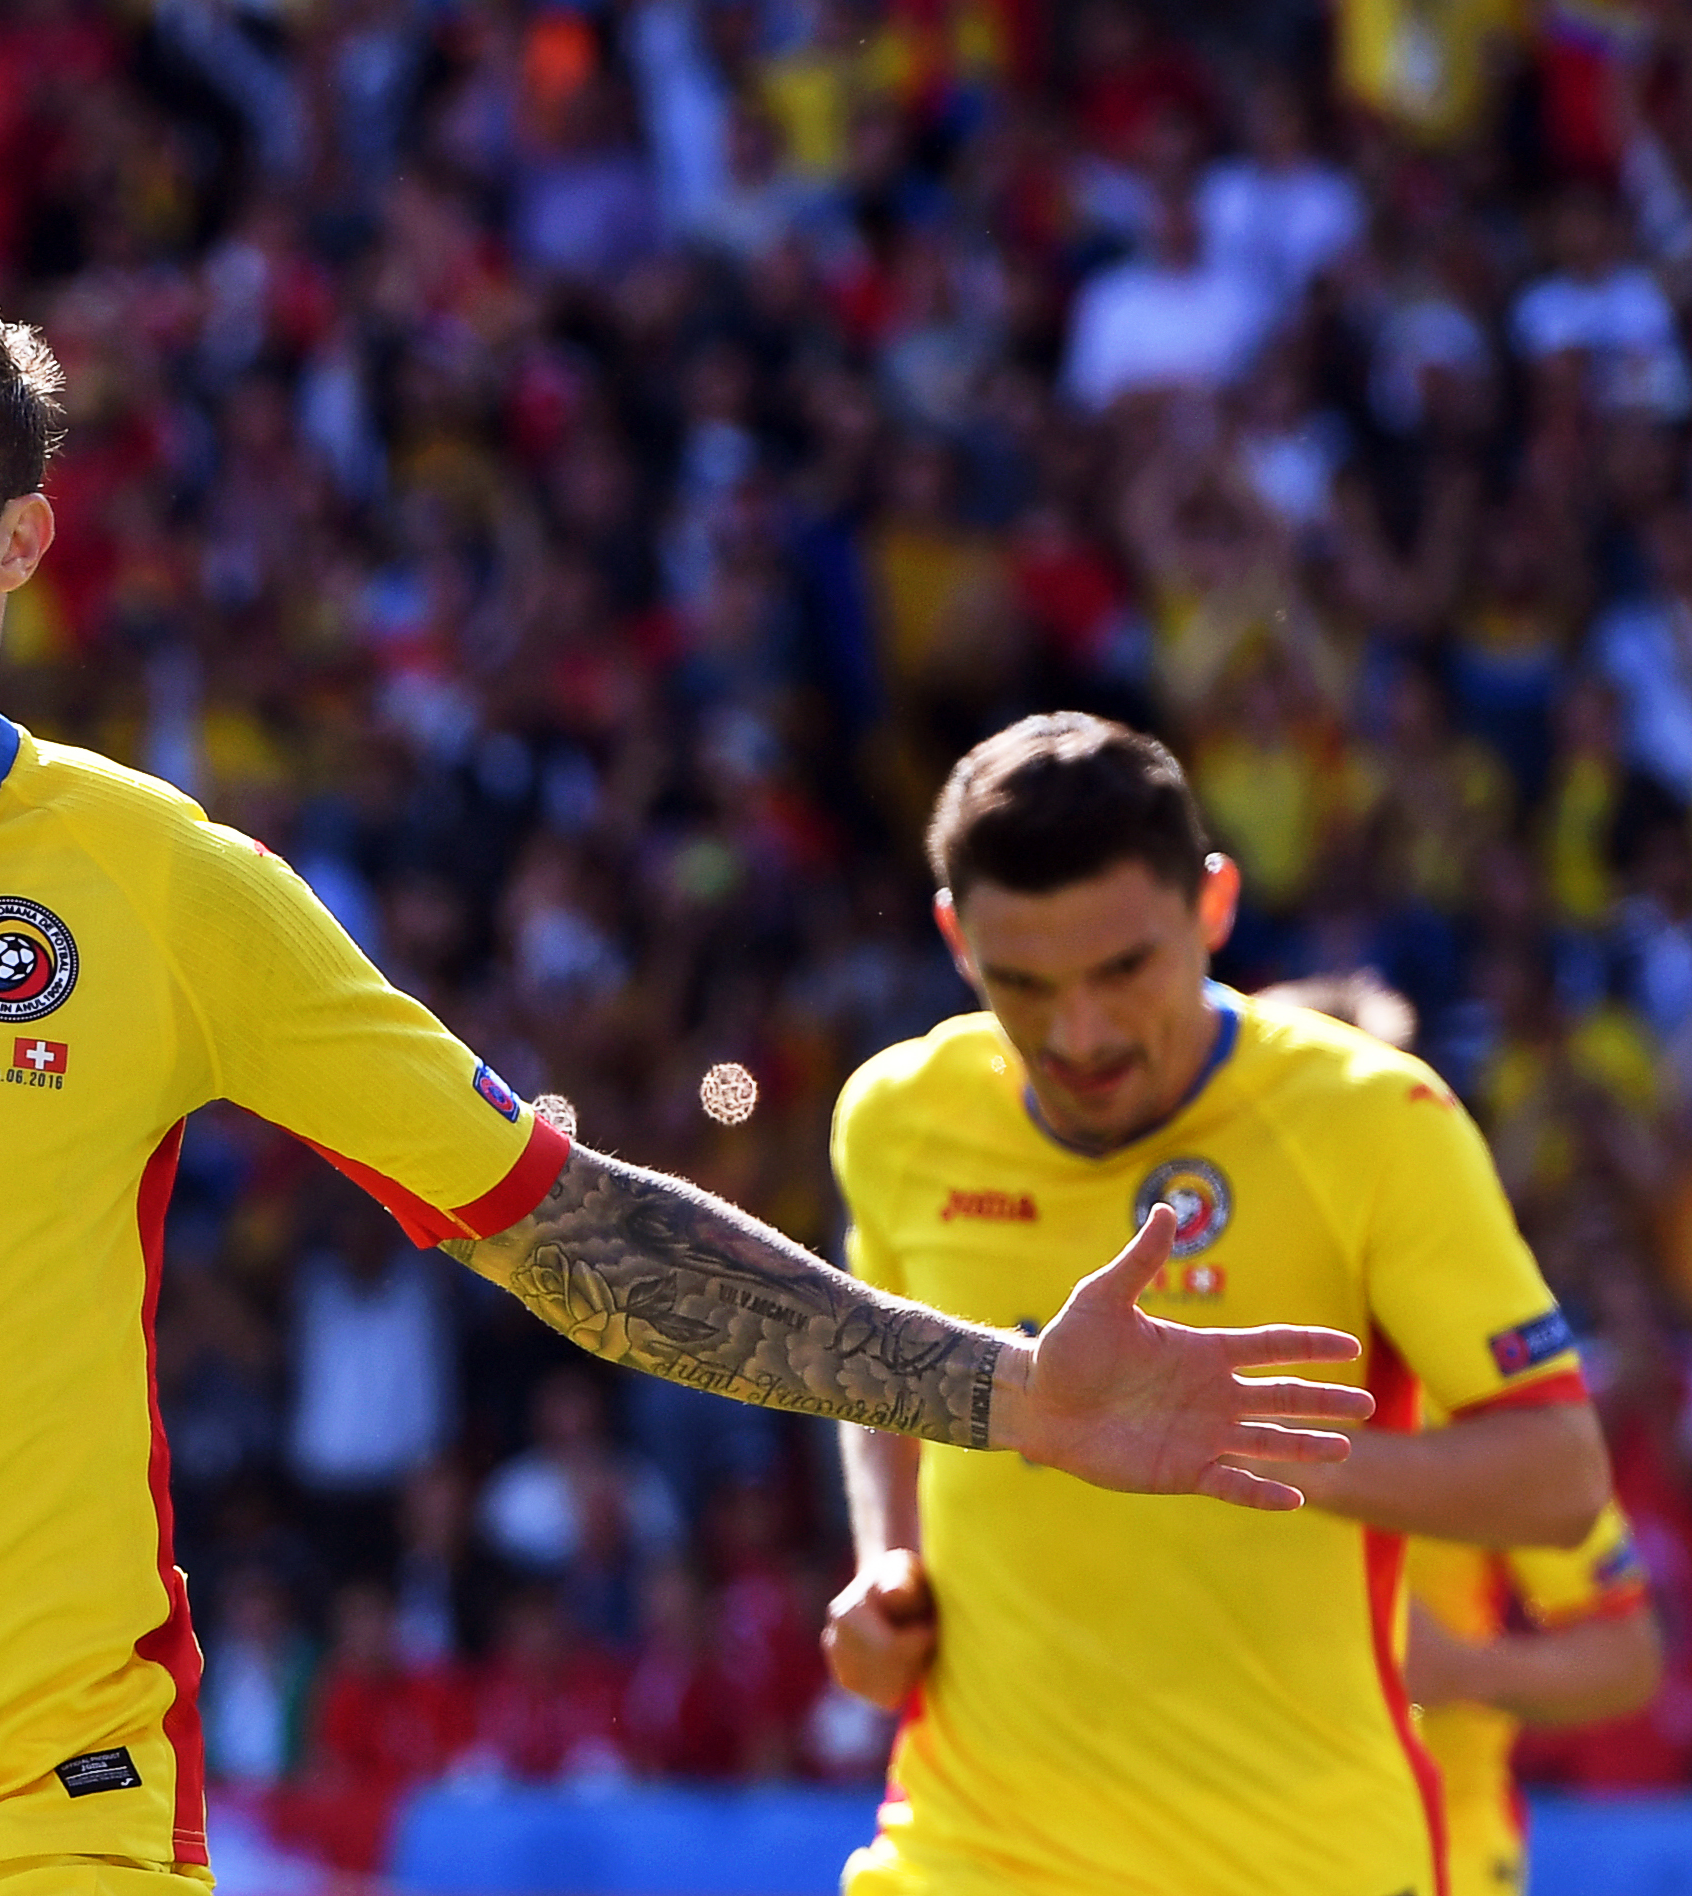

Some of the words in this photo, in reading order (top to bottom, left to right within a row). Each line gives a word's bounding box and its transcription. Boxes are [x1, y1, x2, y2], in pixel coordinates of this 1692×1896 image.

[38, 916, 55, 932] DE
[50, 931, 69, 974] FOTBAL
[0, 1002, 12, 1013] IN
[15, 999, 46, 1013] ANUL
